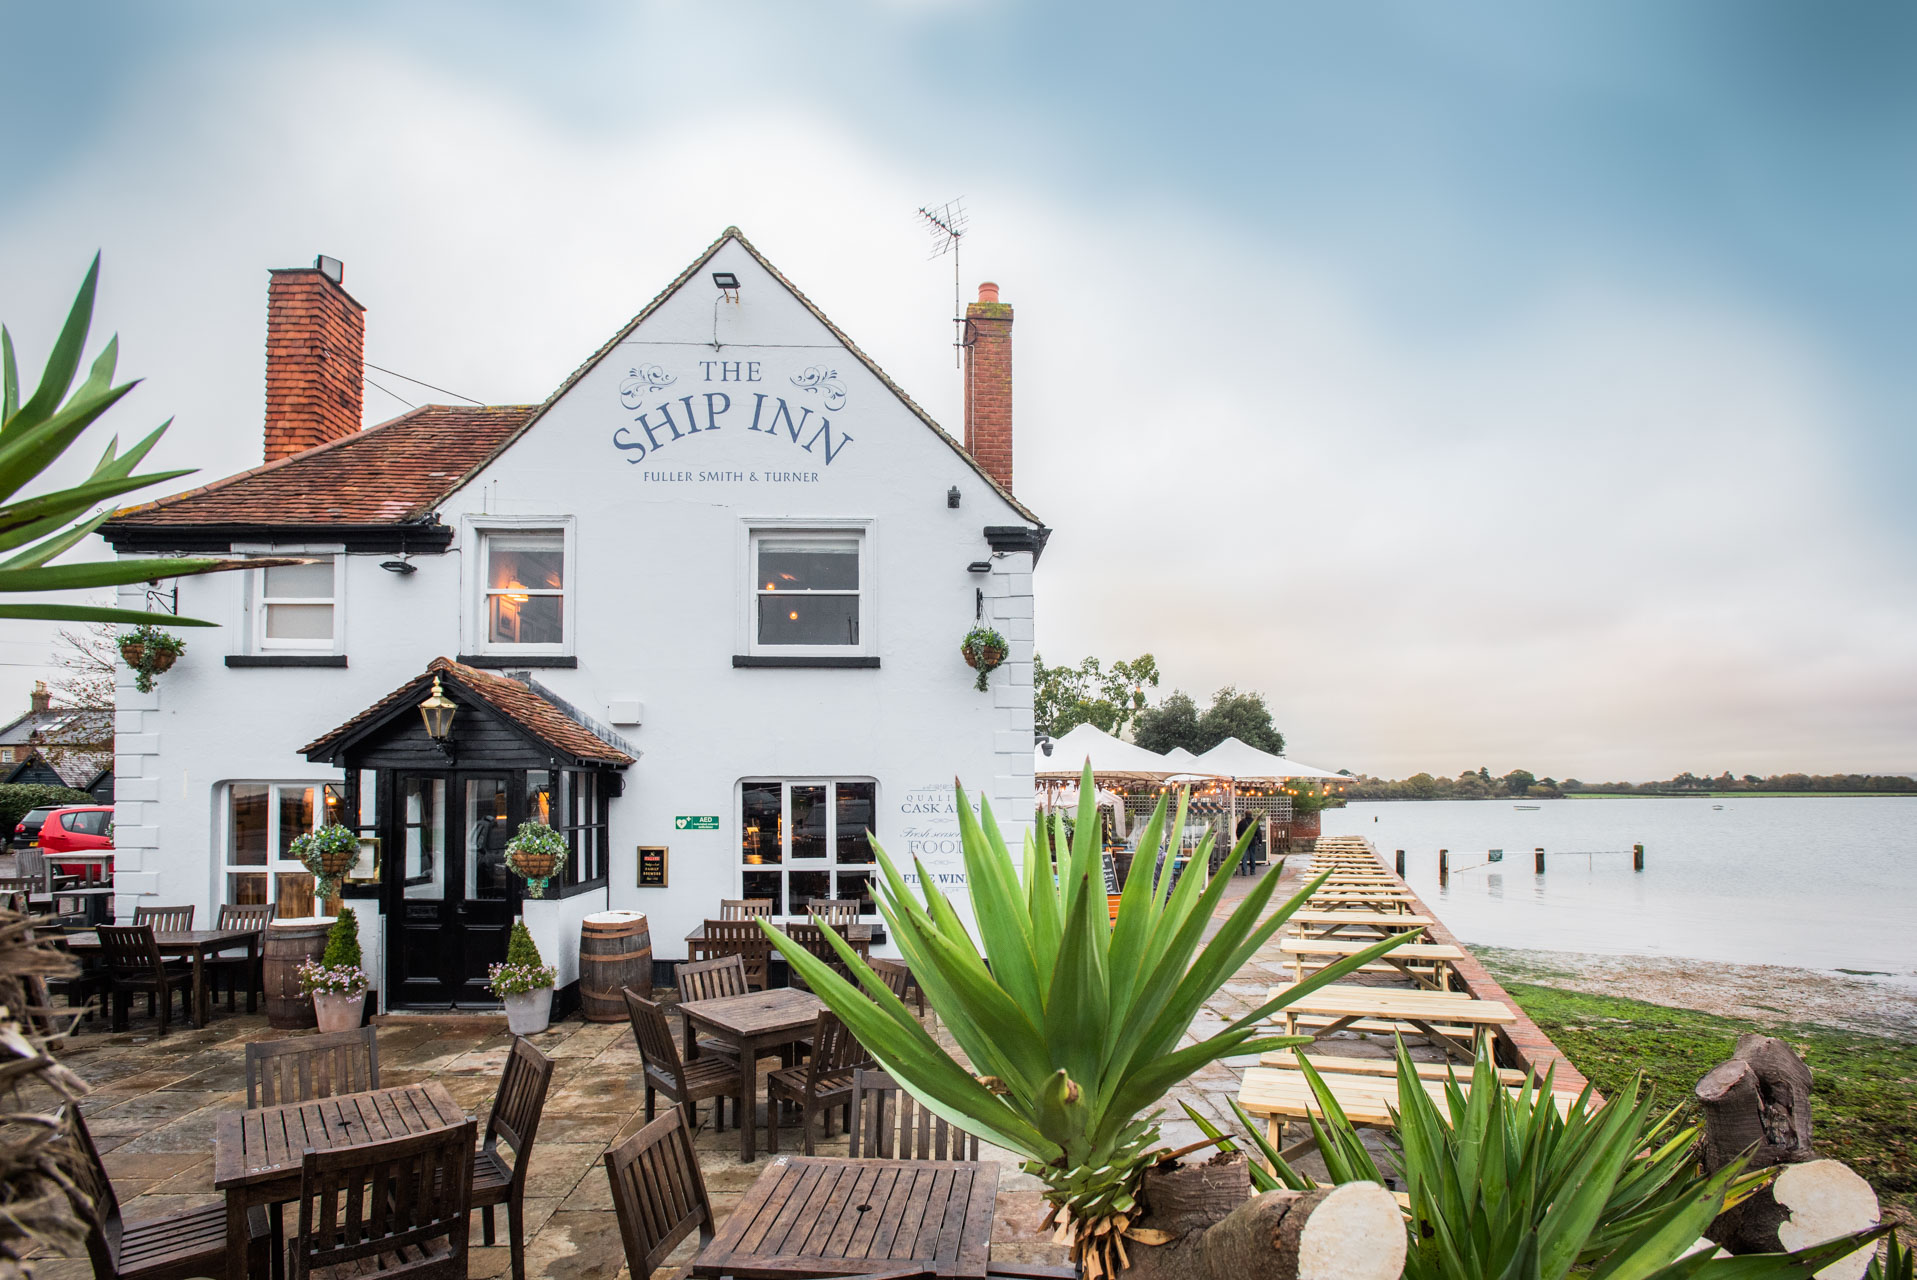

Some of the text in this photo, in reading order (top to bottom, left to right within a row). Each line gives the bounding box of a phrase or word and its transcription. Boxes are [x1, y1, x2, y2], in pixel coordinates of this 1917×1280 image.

[699, 361, 763, 382] THE
[612, 392, 855, 466] SHIP INN
[643, 471, 820, 483] FULLER SMITH & TURNER
[906, 794, 970, 803] QUALI
[901, 803, 980, 814] CASK AS
[900, 826, 932, 838] Fresh
[903, 873, 969, 884] FIE WIN
